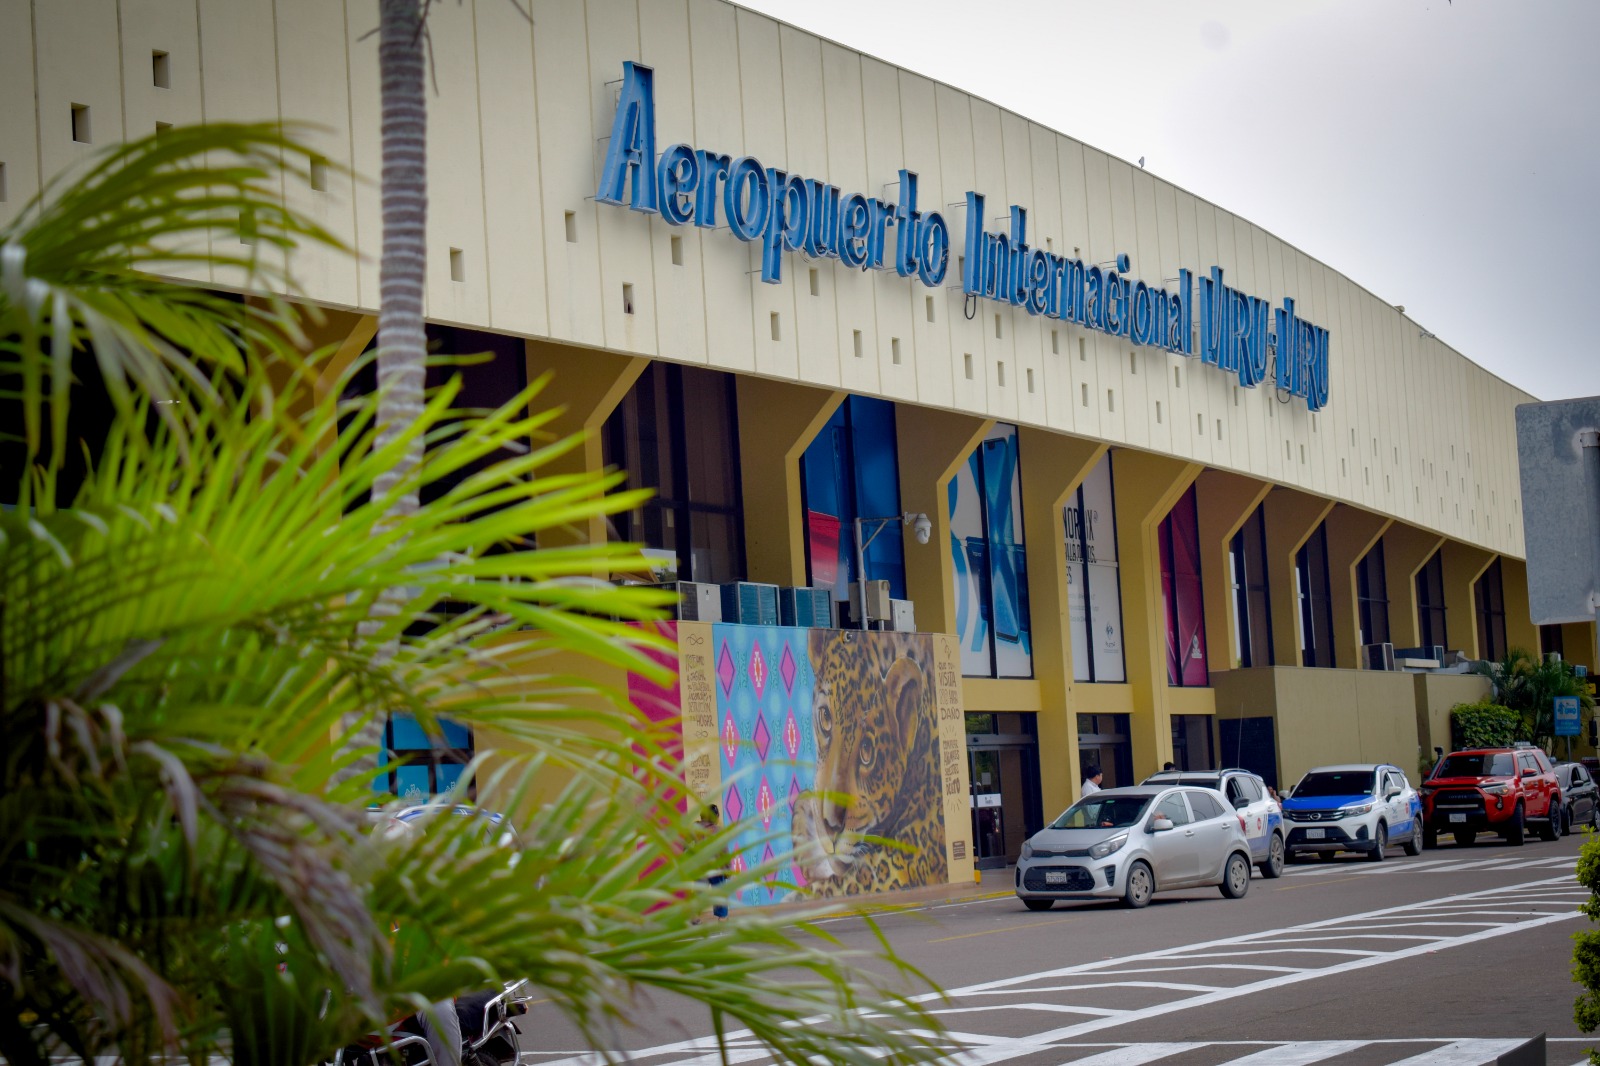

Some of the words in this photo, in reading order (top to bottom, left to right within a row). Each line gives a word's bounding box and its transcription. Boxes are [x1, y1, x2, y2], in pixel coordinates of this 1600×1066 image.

[595, 61, 949, 287] Aeropuerto
[963, 191, 1193, 357] Internacional
[938, 671, 957, 688] VISITA
[940, 706, 960, 721] DAÑO
